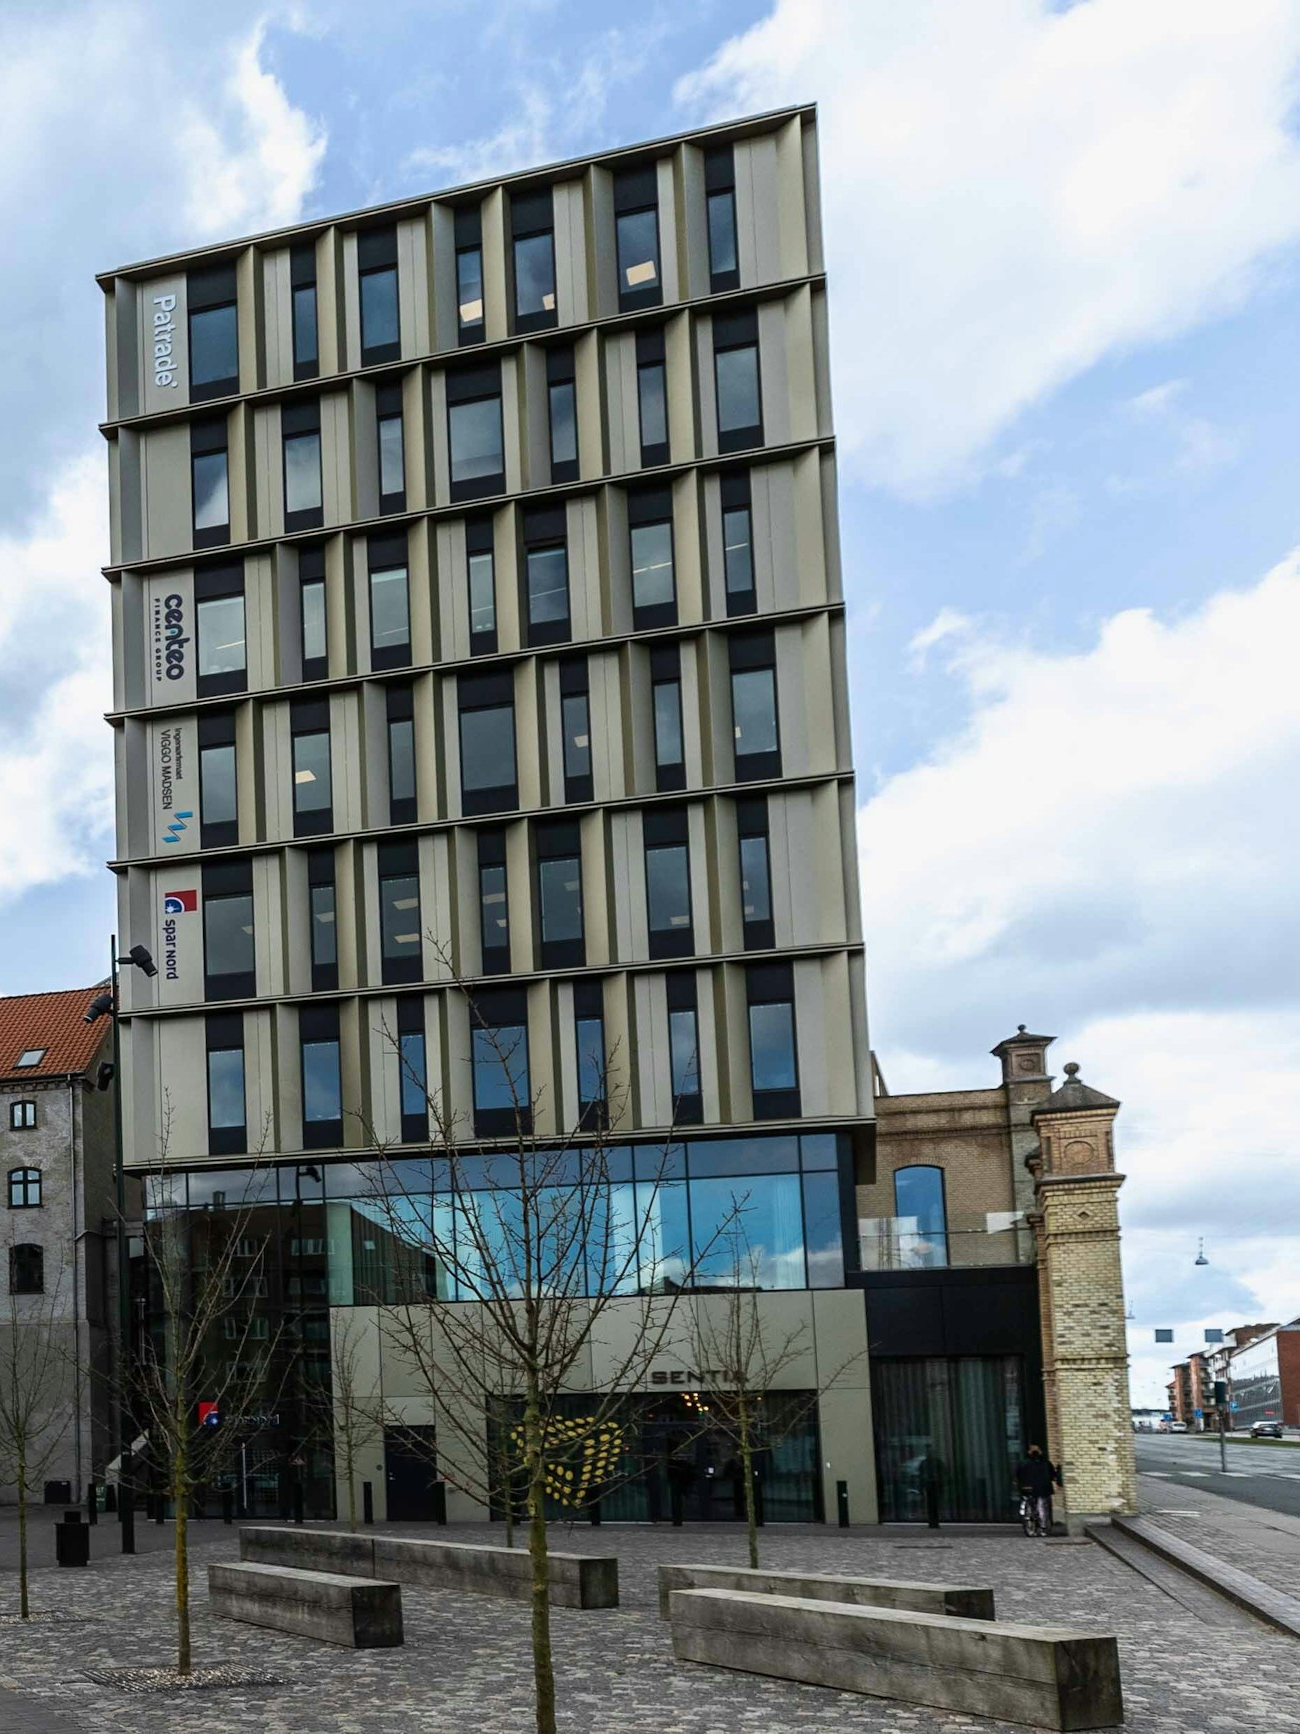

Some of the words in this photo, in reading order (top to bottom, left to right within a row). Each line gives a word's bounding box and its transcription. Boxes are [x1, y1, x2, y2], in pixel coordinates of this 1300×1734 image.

[164, 594, 190, 680] centeo
[161, 729, 172, 763] VIGGO
[162, 766, 172, 810] MADSEN
